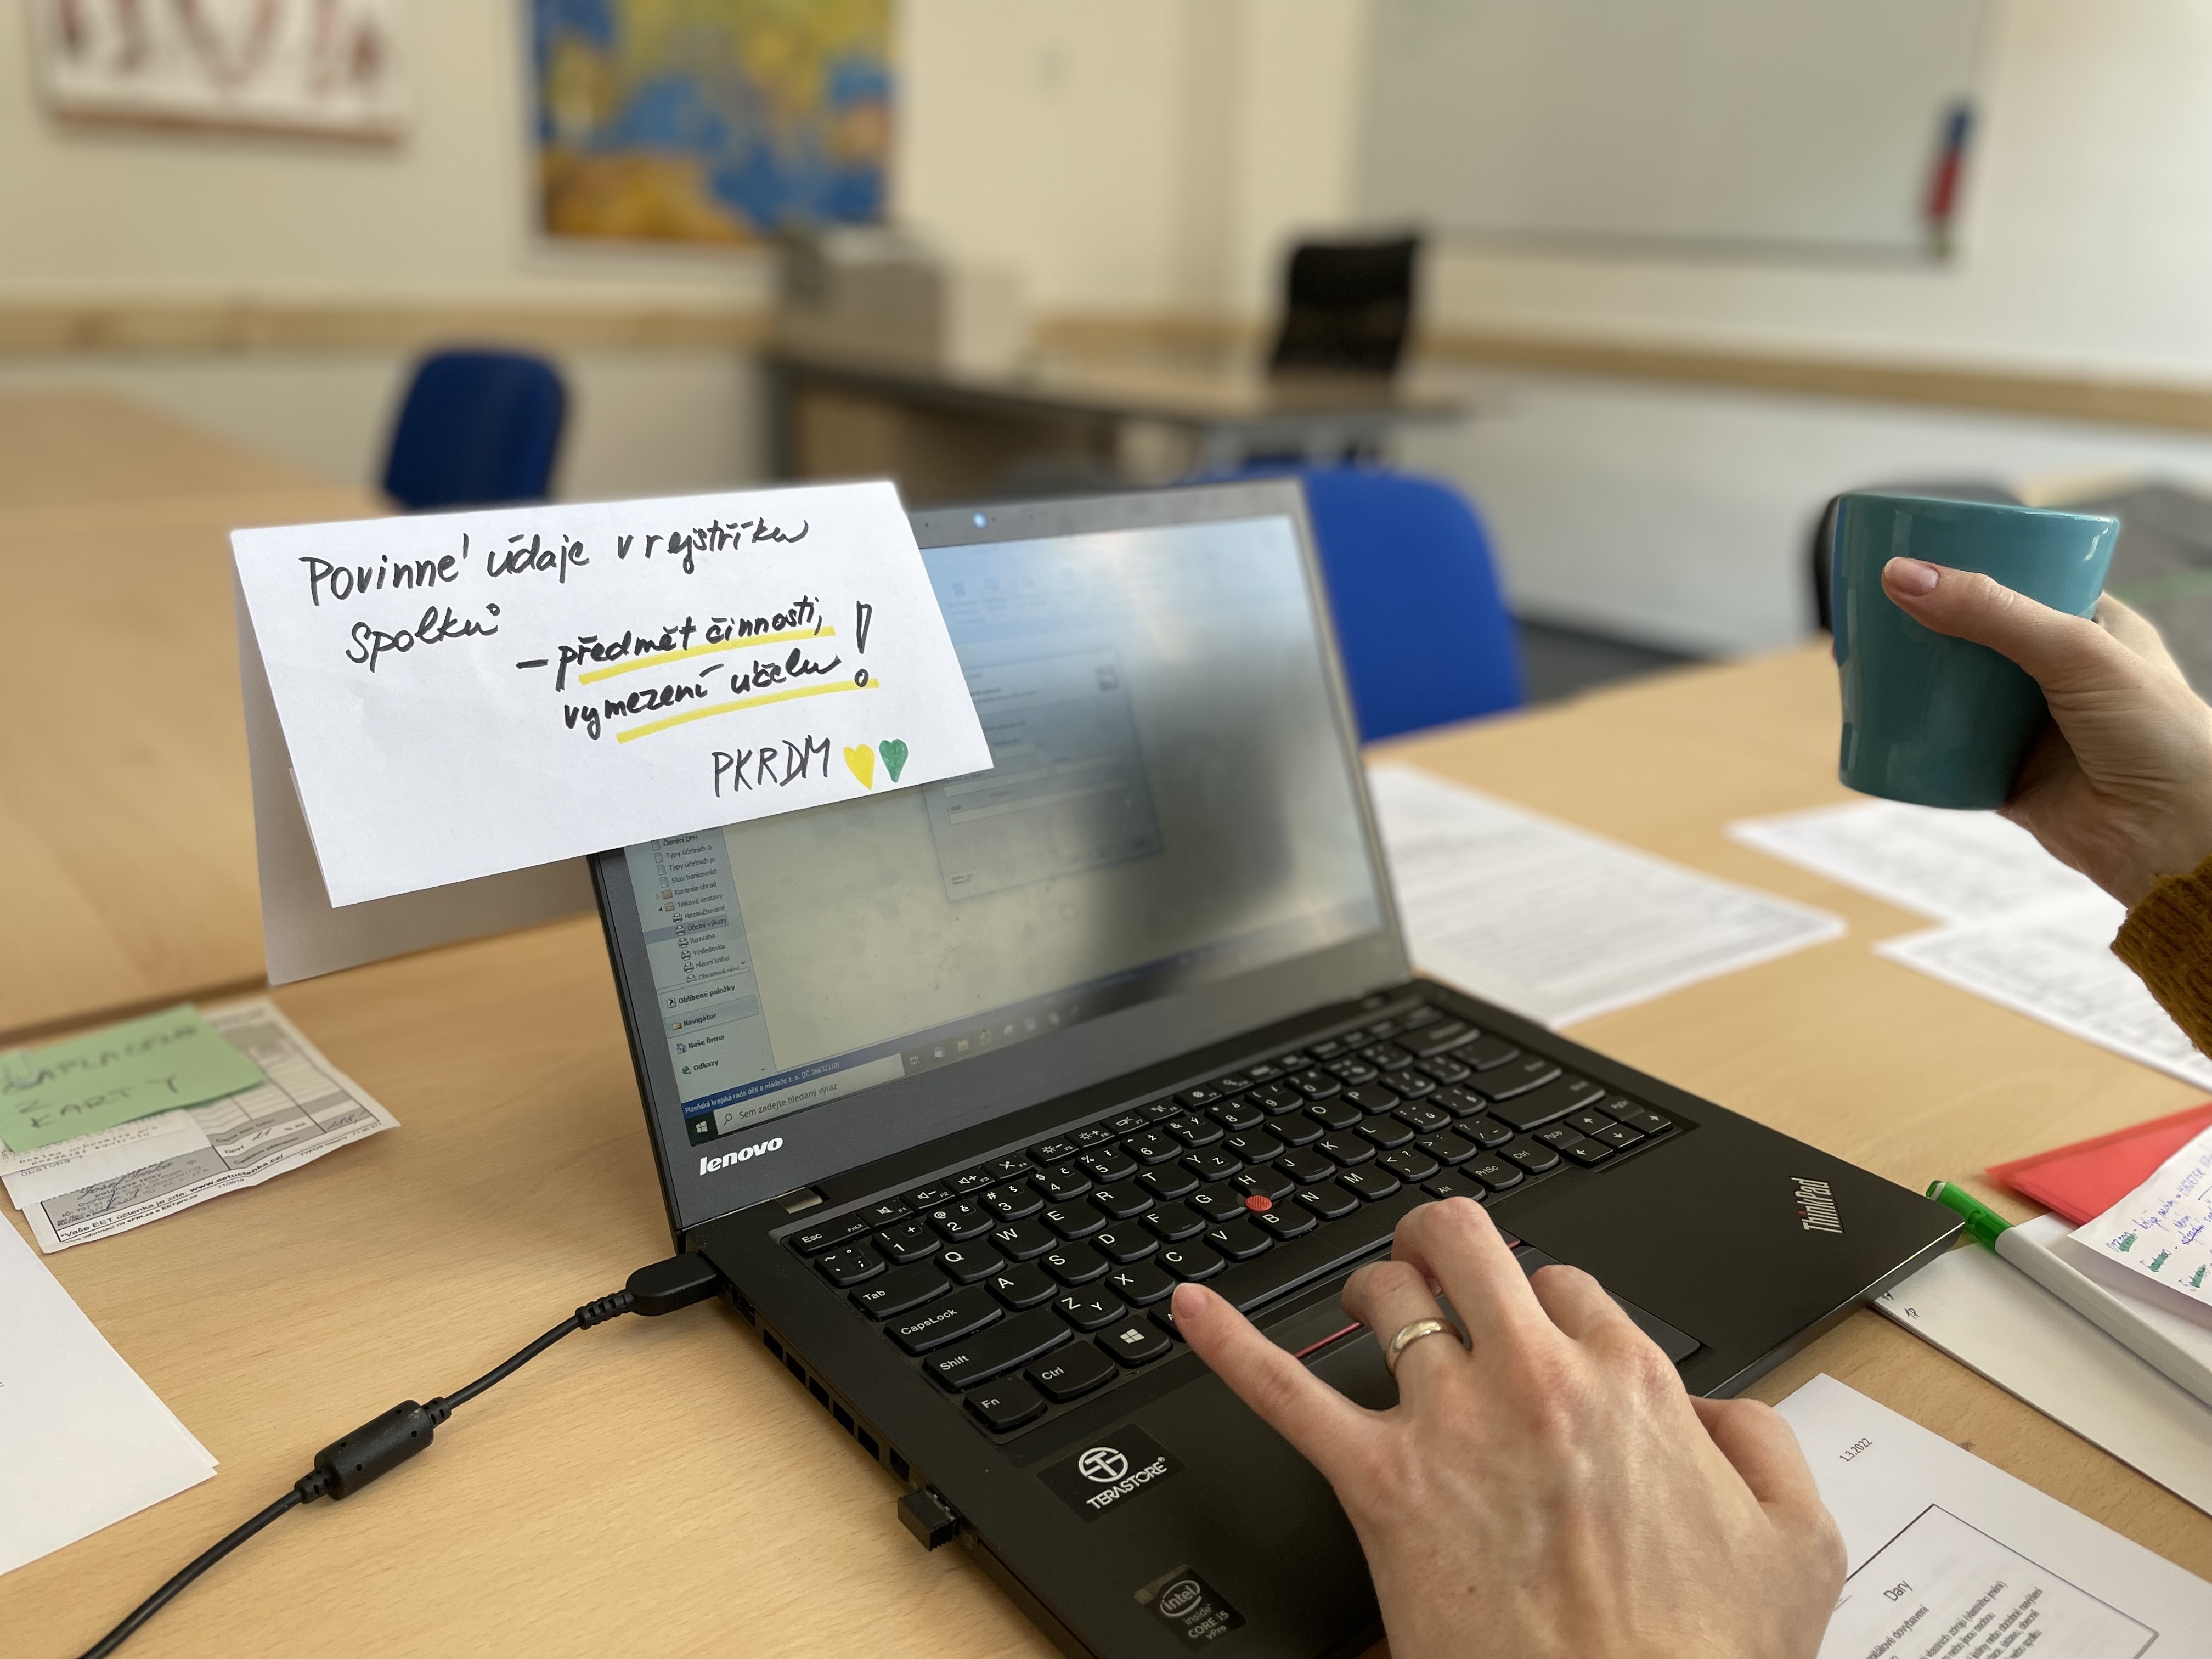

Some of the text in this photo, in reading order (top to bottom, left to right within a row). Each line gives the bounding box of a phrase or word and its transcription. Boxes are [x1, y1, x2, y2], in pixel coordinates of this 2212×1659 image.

[299, 533, 469, 606] Povinné
[488, 534, 589, 583] údaje
[555, 616, 697, 691] předmět
[564, 664, 724, 741] vymezení
[713, 734, 831, 798] PKRDM
[666, 850, 681, 860] Typy
[669, 862, 684, 872] Typy
[674, 881, 717, 896] Kontrola úhrad
[678, 894, 723, 908] Tiskové sestavy
[707, 918, 727, 927] výkazy
[690, 933, 715, 944] Rozvaha
[693, 944, 725, 956] Výsledovka
[696, 955, 730, 968] Hlavní kniha
[679, 985, 735, 1004] Oblíbené položky
[684, 1013, 716, 1026] Navigátor
[688, 1035, 725, 1049] Naše firma
[693, 1059, 719, 1071] Odkazy
[685, 1101, 710, 1114] Plzeňská
[711, 1093, 732, 1107] krajská
[733, 1089, 747, 1098] rada
[738, 1081, 838, 1119] Sem zadejte hledaný výraz
[1348, 1092, 1359, 1100] P
[1182, 1130, 1194, 1138] 7
[1229, 1138, 1245, 1147] U
[1321, 1141, 1339, 1150] K
[699, 1137, 783, 1176] lenovo
[1186, 1154, 1201, 1164] Y
[1513, 1150, 1530, 1159] Ctrl
[1284, 1159, 1295, 1167] J
[1095, 1165, 1108, 1173] 5
[1475, 1165, 1498, 1177] PrtSc
[1142, 1172, 1157, 1181] T
[1238, 1175, 1256, 1185] H
[1344, 1173, 1363, 1183] M
[1438, 1186, 1452, 1194] Alt
[1096, 1191, 1114, 1201] R
[1195, 1194, 1213, 1204] G
[1301, 1192, 1320, 1202] N
[998, 1202, 1012, 1211] 3
[1791, 1177, 1842, 1233] ThinkPad
[1047, 1210, 1065, 1221] E
[1147, 1213, 1159, 1223] F
[1262, 1214, 1280, 1223] B
[947, 1222, 962, 1231] 2
[801, 1233, 822, 1243] Esc
[996, 1228, 1018, 1240] W
[1098, 1234, 1115, 1244] D
[1211, 1230, 1228, 1240] V
[945, 1251, 964, 1262] Q
[1049, 1255, 1065, 1265] S
[1166, 1252, 1182, 1262] C
[998, 1278, 1014, 1289] A
[1114, 1273, 1134, 1285] X
[862, 1290, 886, 1301] Tab
[1061, 1297, 1081, 1310] Z
[1091, 1302, 1102, 1311] Y
[901, 1309, 957, 1335] CapsLock
[940, 1355, 969, 1370] Shift
[1042, 1367, 1064, 1380] Ctrl
[981, 1398, 1000, 1408] Fn
[1839, 1438, 1873, 1462] 1.3.2022
[1883, 1580, 1913, 1602] Dary
[1163, 1584, 1198, 1611] intel
[1188, 1610, 1229, 1639] CORE i5
